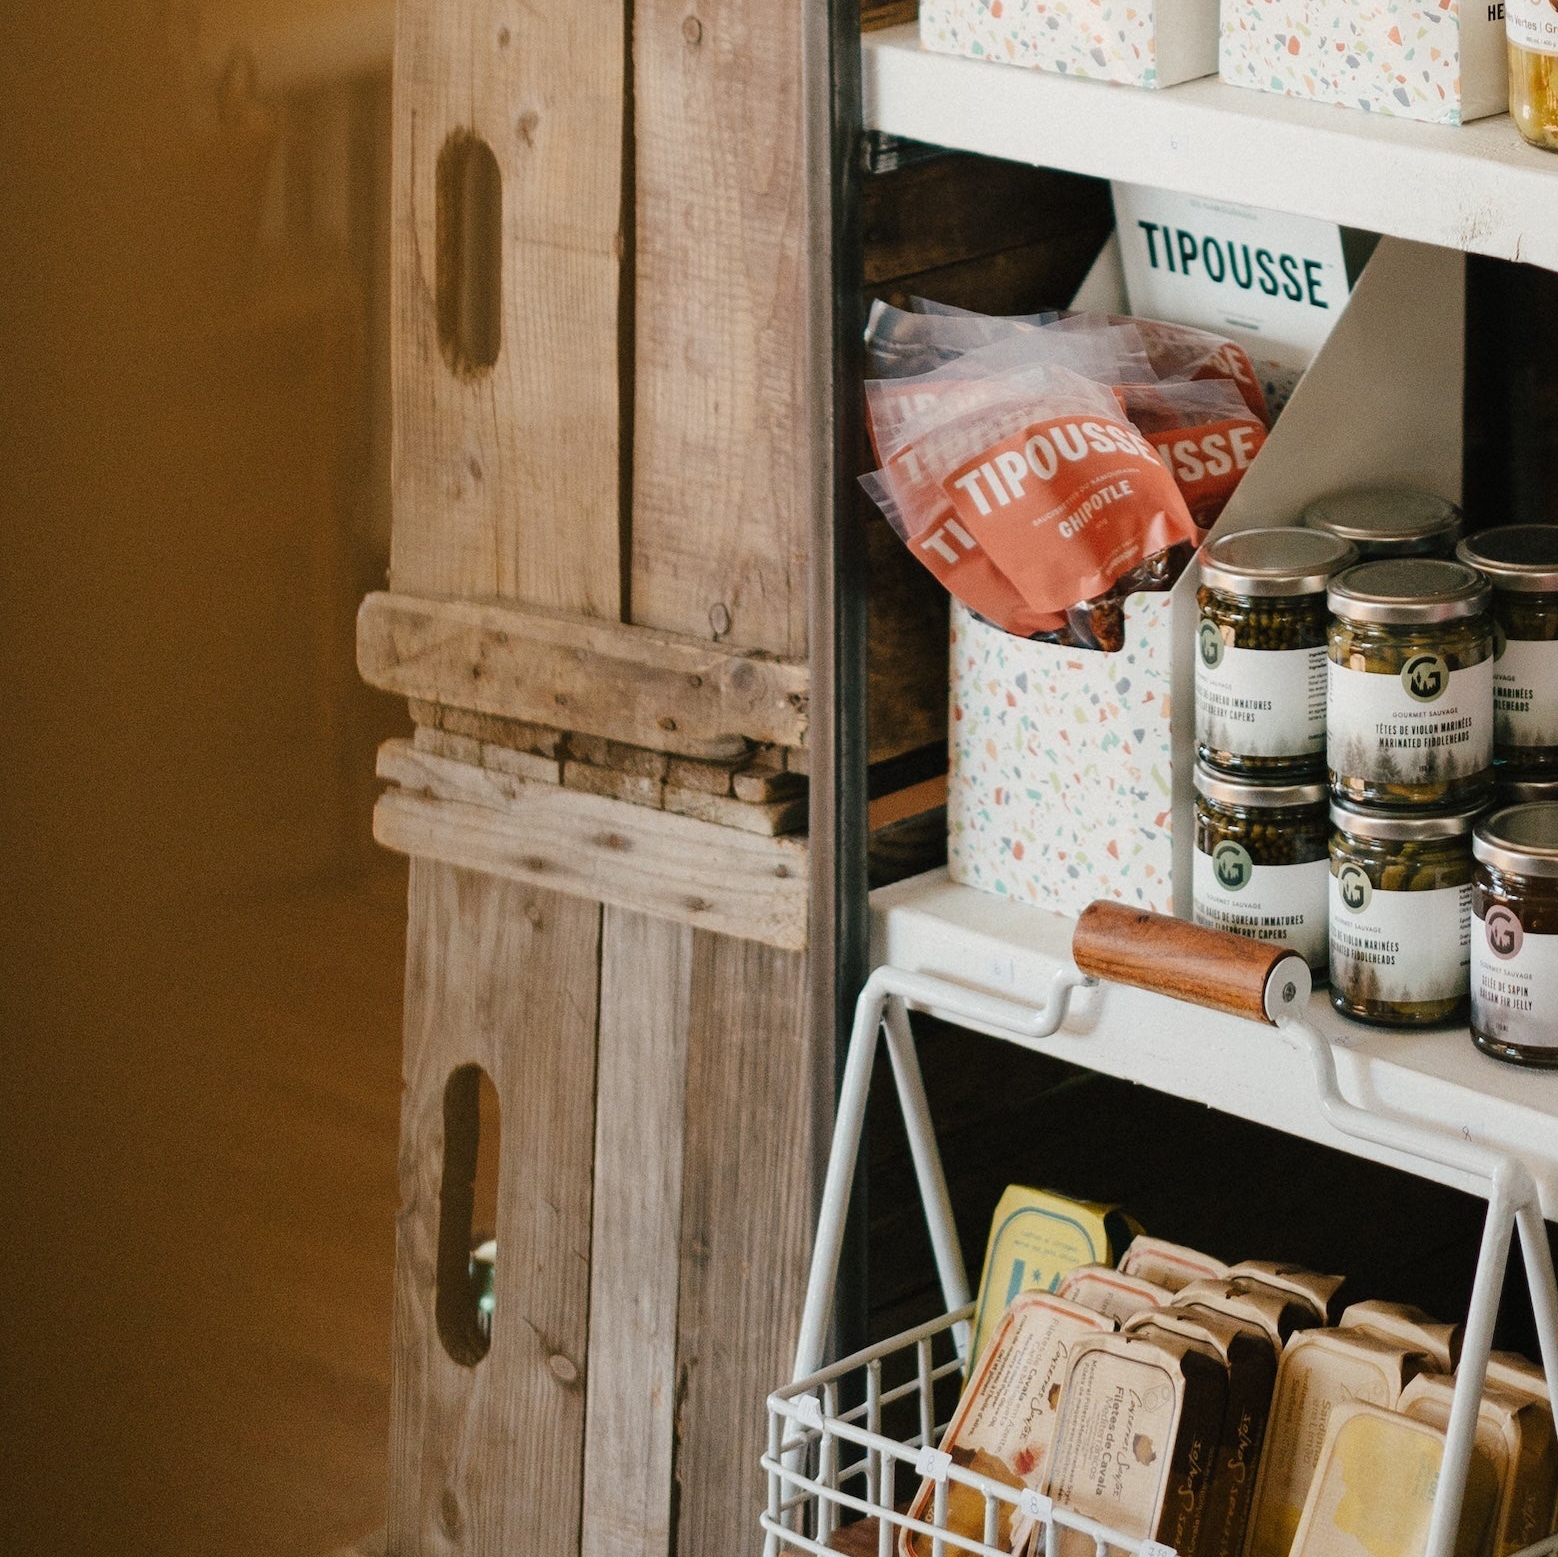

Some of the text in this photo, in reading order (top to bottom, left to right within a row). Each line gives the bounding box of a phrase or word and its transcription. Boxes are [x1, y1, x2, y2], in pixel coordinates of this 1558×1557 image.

[1514, 14, 1537, 31] Vertes
[1137, 219, 1330, 310] TIPOUSSE
[955, 419, 1162, 517] TIPOUSSE
[1057, 478, 1134, 539] CHIPOTLE
[921, 521, 978, 565] TI
[1232, 698, 1272, 711] IMMATURES
[1230, 709, 1256, 723] CAPERS
[1392, 707, 1458, 719] GOURMET SAUVAGE
[1376, 717, 1472, 735] TÊTES DE VIOLON MARINÉES
[1378, 732, 1470, 748] MARINATED FIDDLEHEADS
[1231, 901, 1262, 910] SAUVAGE
[1231, 913, 1304, 927] SUREAU IMMATURES
[1257, 928, 1288, 940] CAPERS
[1355, 924, 1382, 933] SAUVAGE
[1344, 933, 1399, 952] VIOLON MARINÉES
[1352, 949, 1396, 965] FIDDLEHEADS
[1504, 969, 1532, 980] SAUVAGE
[1499, 981, 1528, 996] DE SAPIN
[1501, 996, 1510, 1007] FIR
[1513, 999, 1532, 1010] JELLY
[1017, 1367, 1038, 1401] Cavala
[1086, 1361, 1098, 1393] Mackerel
[1080, 1395, 1092, 1422] Fillets
[1095, 1386, 1124, 1495] Filetes de Cavala
